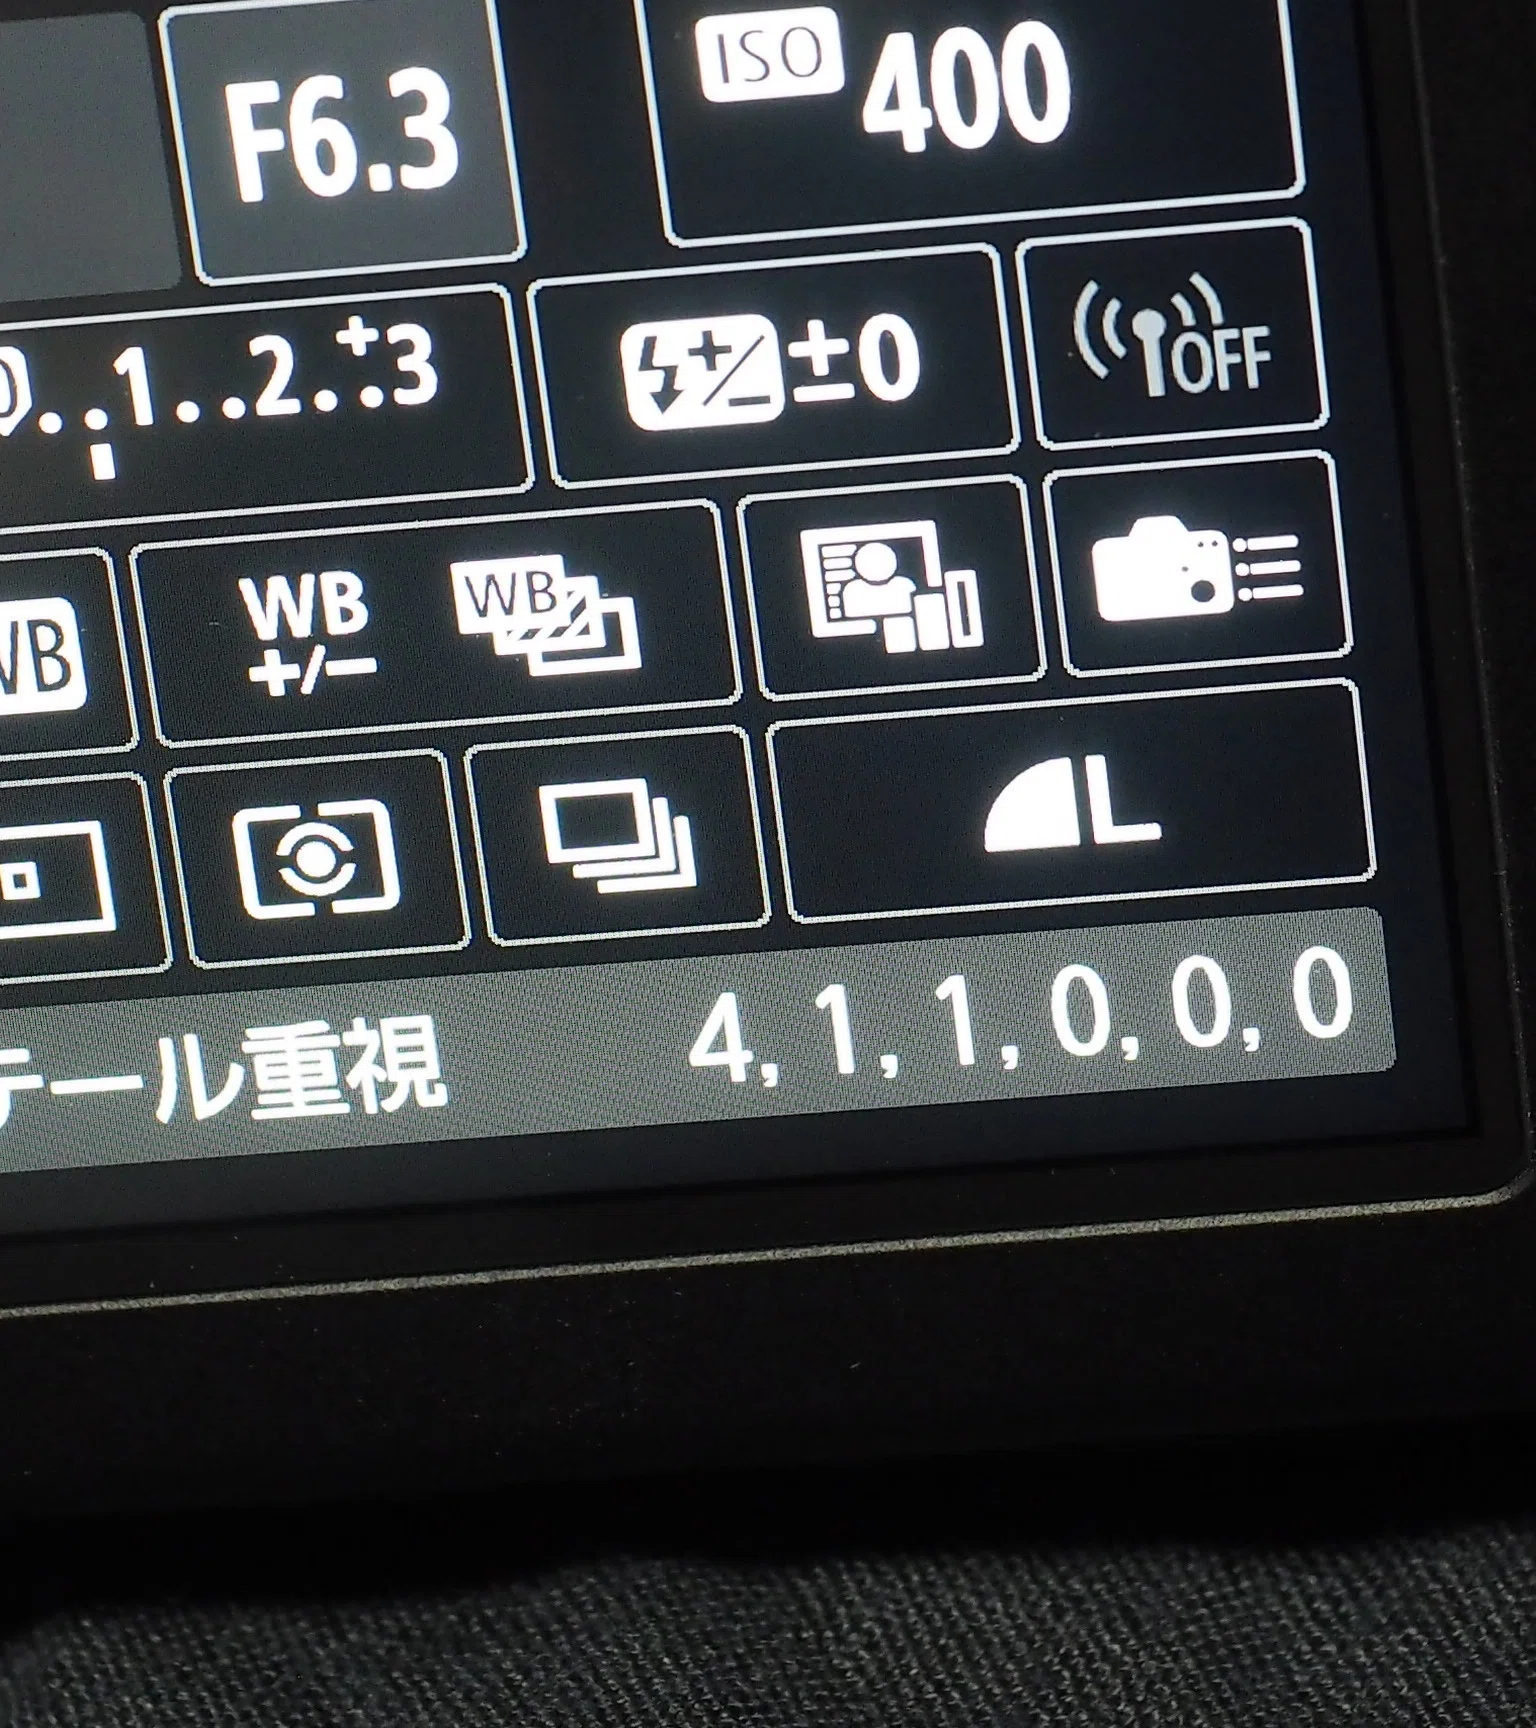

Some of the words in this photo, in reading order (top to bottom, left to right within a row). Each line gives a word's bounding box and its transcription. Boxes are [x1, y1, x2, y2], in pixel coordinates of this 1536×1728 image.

[717, 26, 823, 84] ISO
[862, 20, 1071, 153] 400
[224, 66, 459, 203] F6.3
[1171, 325, 1271, 394] OFF
[238, 570, 369, 641] WB
[464, 570, 558, 618] WB
